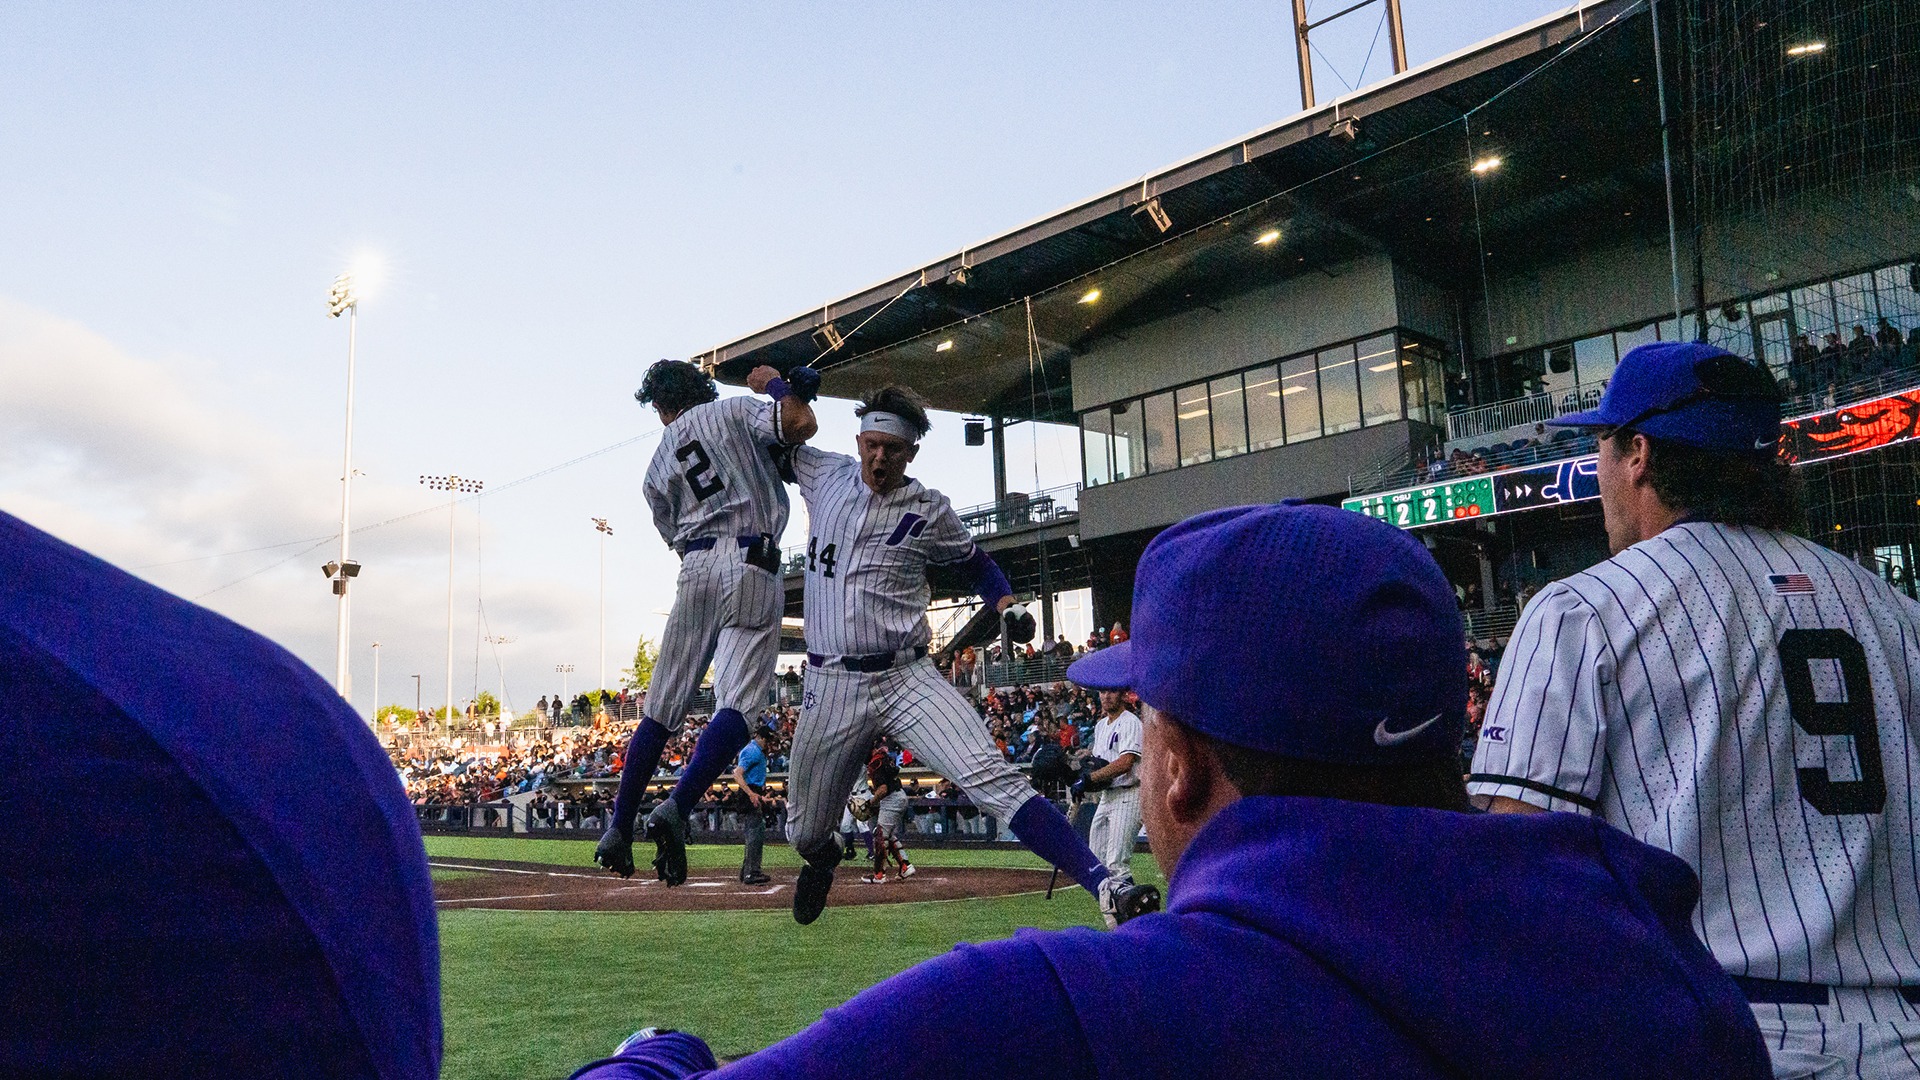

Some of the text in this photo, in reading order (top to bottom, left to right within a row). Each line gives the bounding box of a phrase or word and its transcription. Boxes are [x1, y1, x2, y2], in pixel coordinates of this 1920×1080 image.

[676, 440, 725, 502] 2
[1392, 493, 1411, 502] OSU
[1422, 488, 1435, 497] UP
[1362, 499, 1369, 507] H
[1377, 505, 1384, 516] 0
[1424, 499, 1437, 521] 2
[1446, 498, 1452, 507] S
[1397, 503, 1410, 525] 2
[808, 536, 836, 578] 44
[1777, 628, 1887, 815] 9
